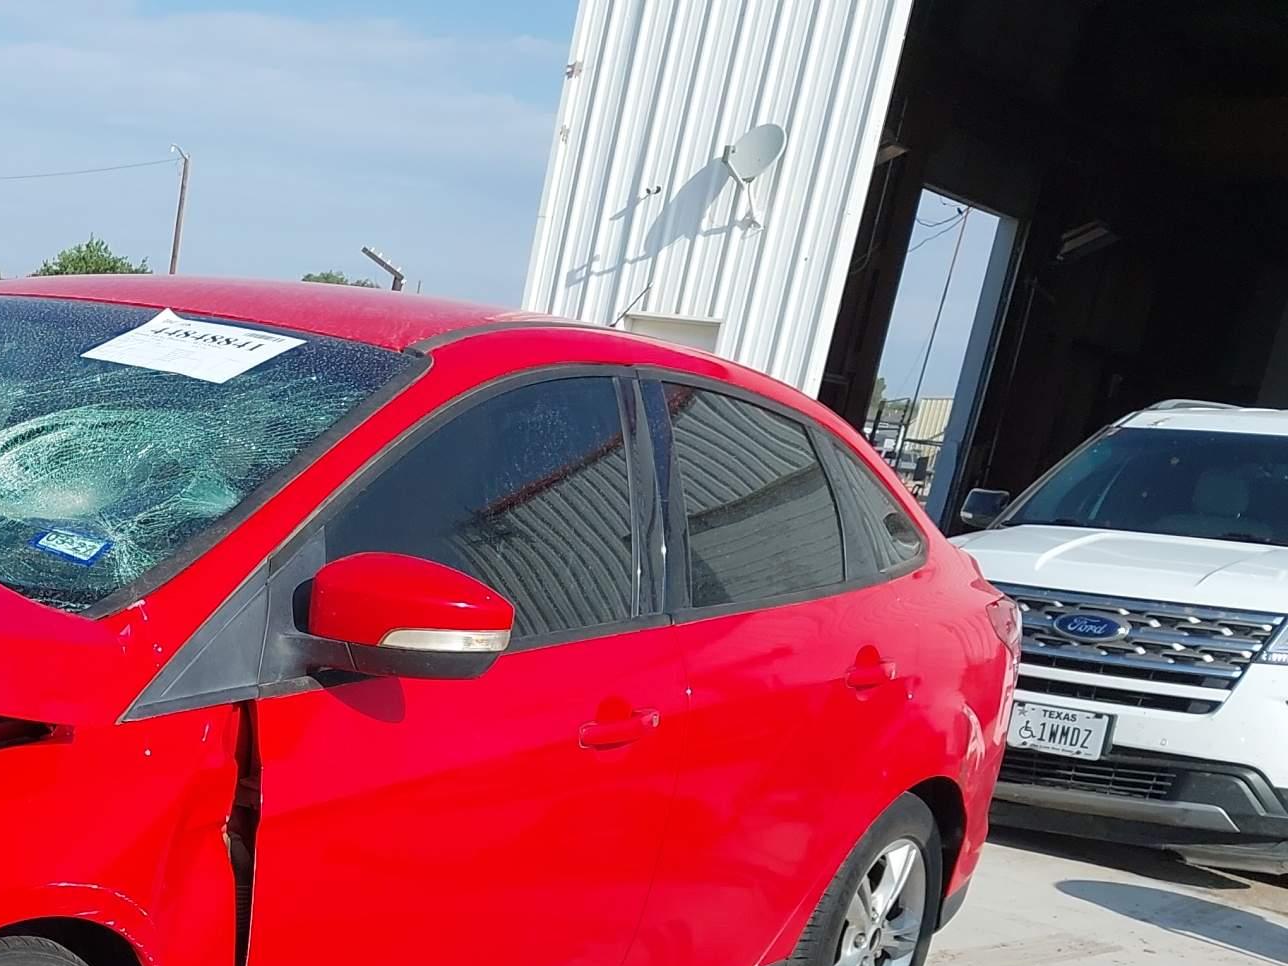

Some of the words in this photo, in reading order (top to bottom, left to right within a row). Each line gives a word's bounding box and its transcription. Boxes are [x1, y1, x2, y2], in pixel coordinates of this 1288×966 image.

[150, 326, 265, 352] 44848841
[1067, 617, 1108, 635] Ford
[1042, 709, 1078, 722] TEXAS
[1037, 722, 1093, 749] 1WMDZ
